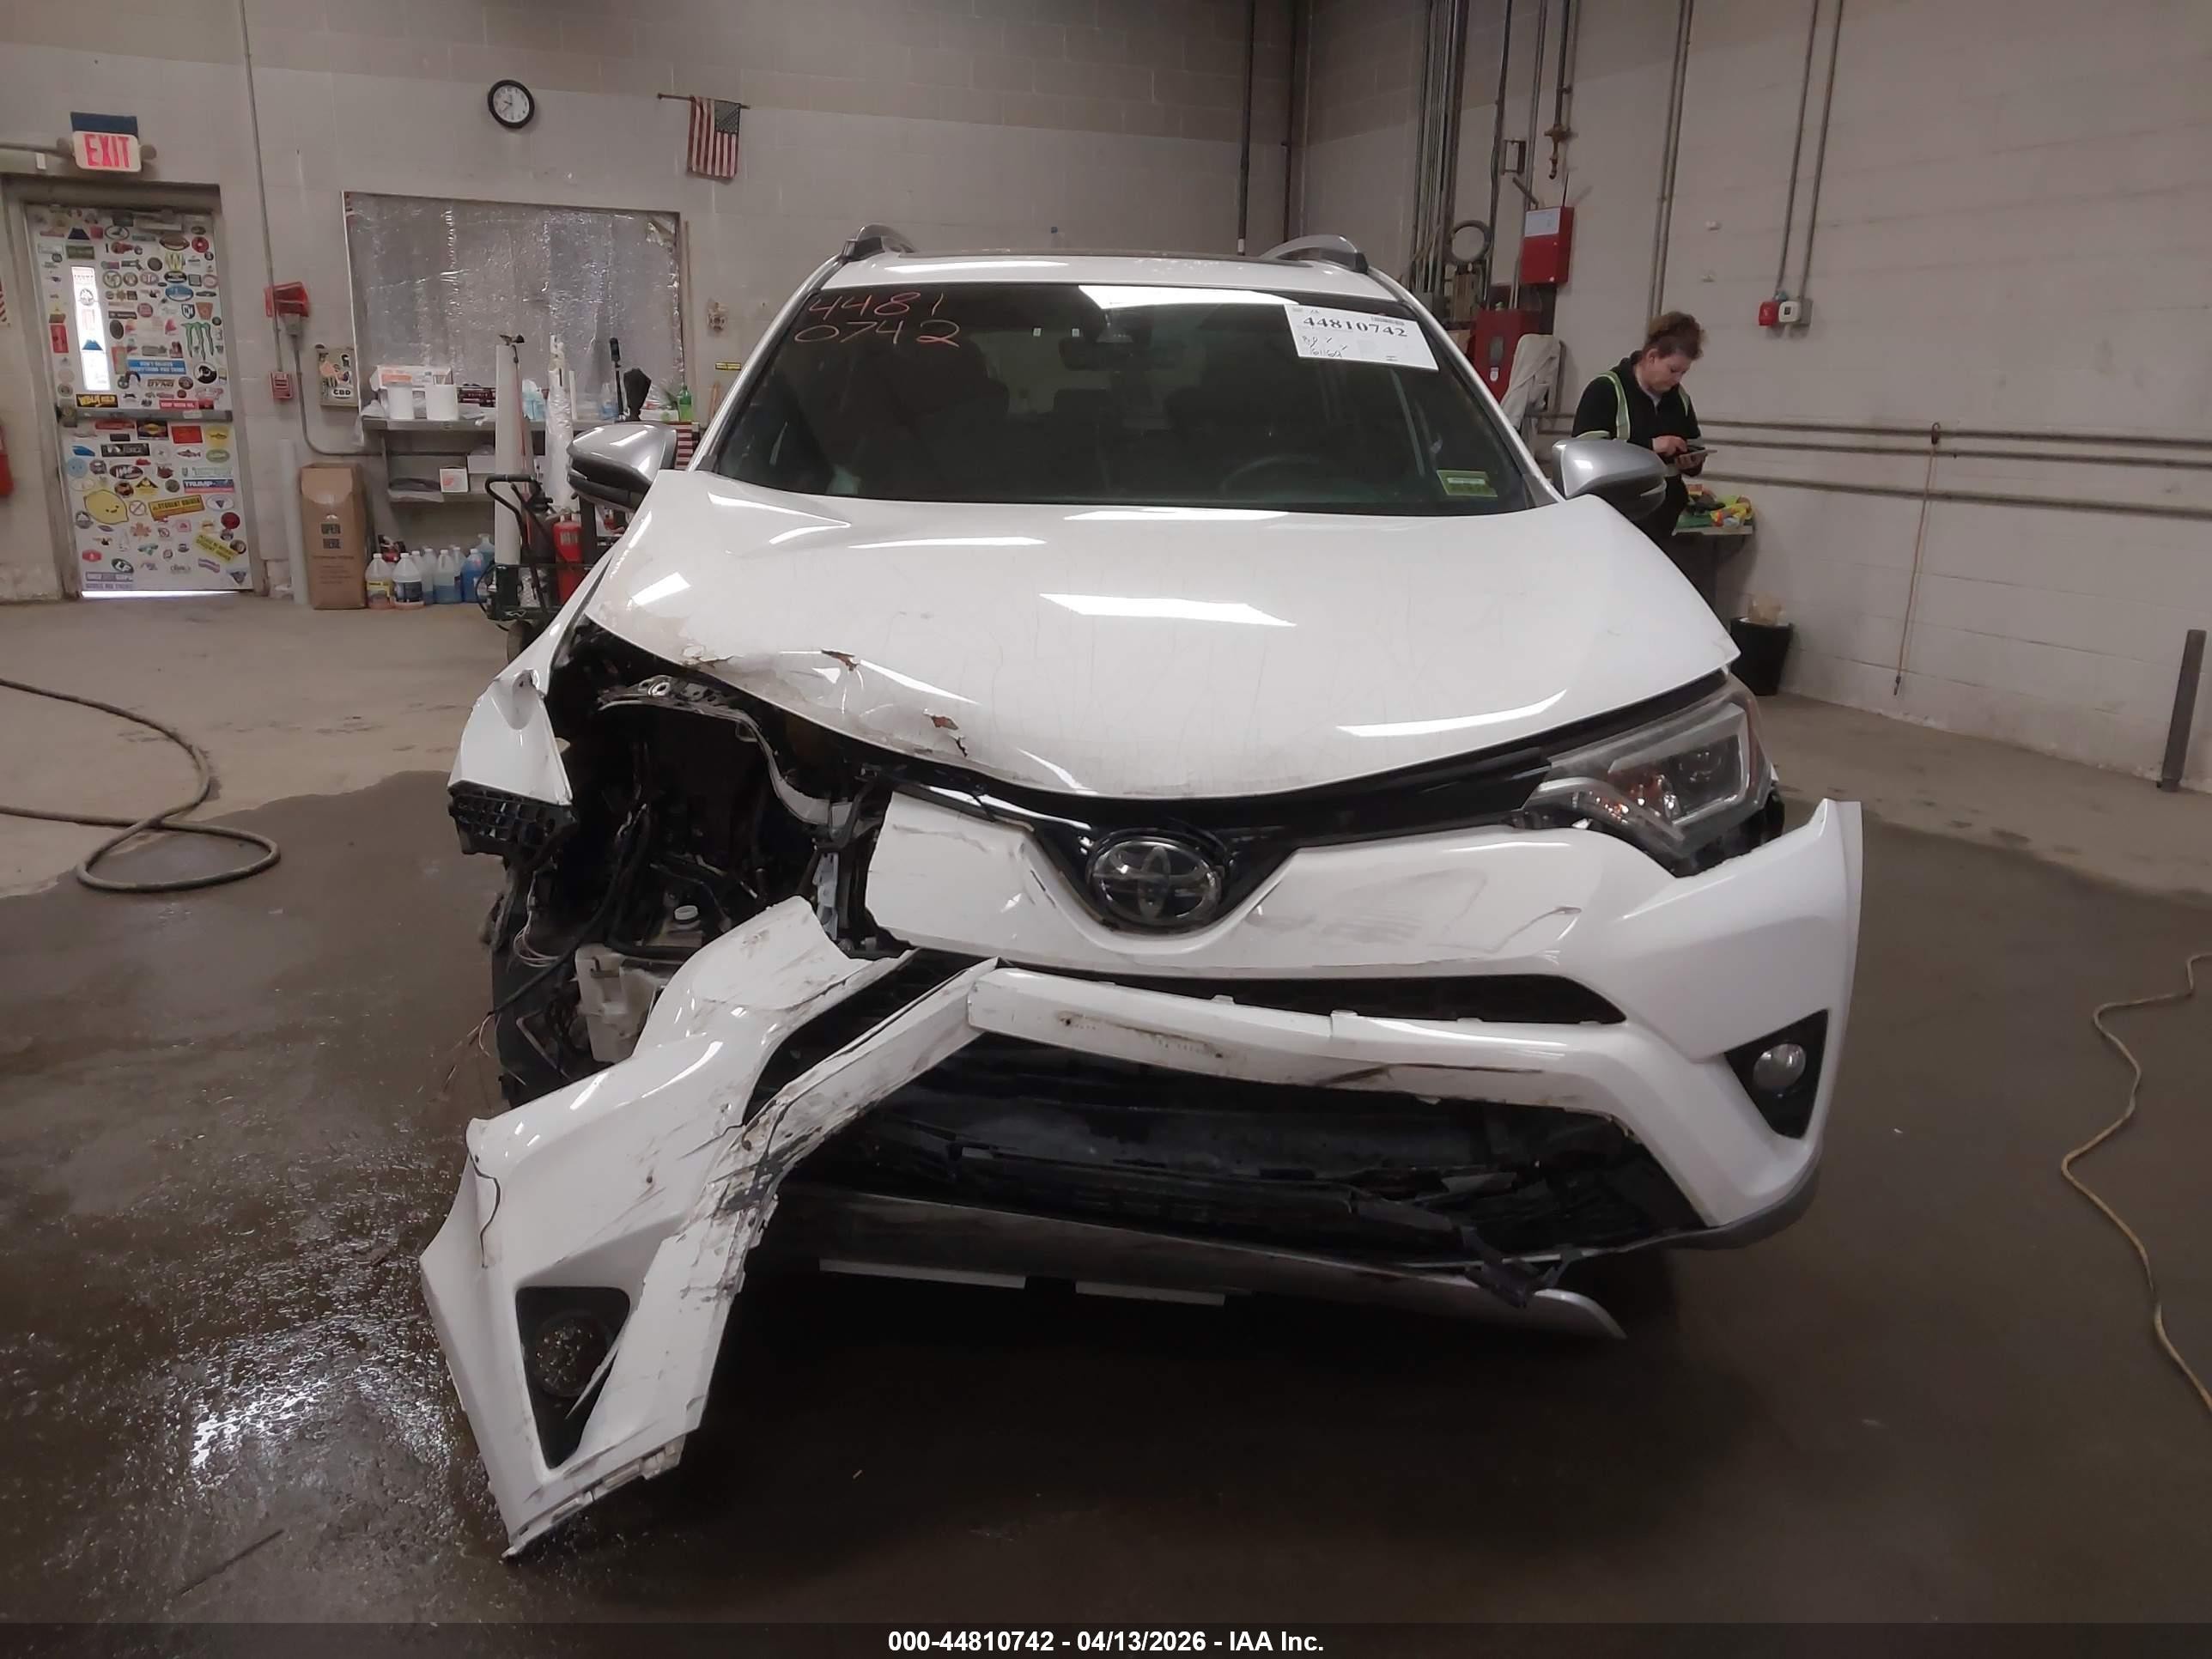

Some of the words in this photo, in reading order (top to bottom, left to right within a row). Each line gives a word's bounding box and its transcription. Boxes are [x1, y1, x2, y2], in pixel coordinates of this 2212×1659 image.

[83, 133, 131, 167] EXIT
[809, 292, 944, 320] 4481
[794, 319, 960, 348] 0742
[1304, 316, 1408, 337] 44810742
